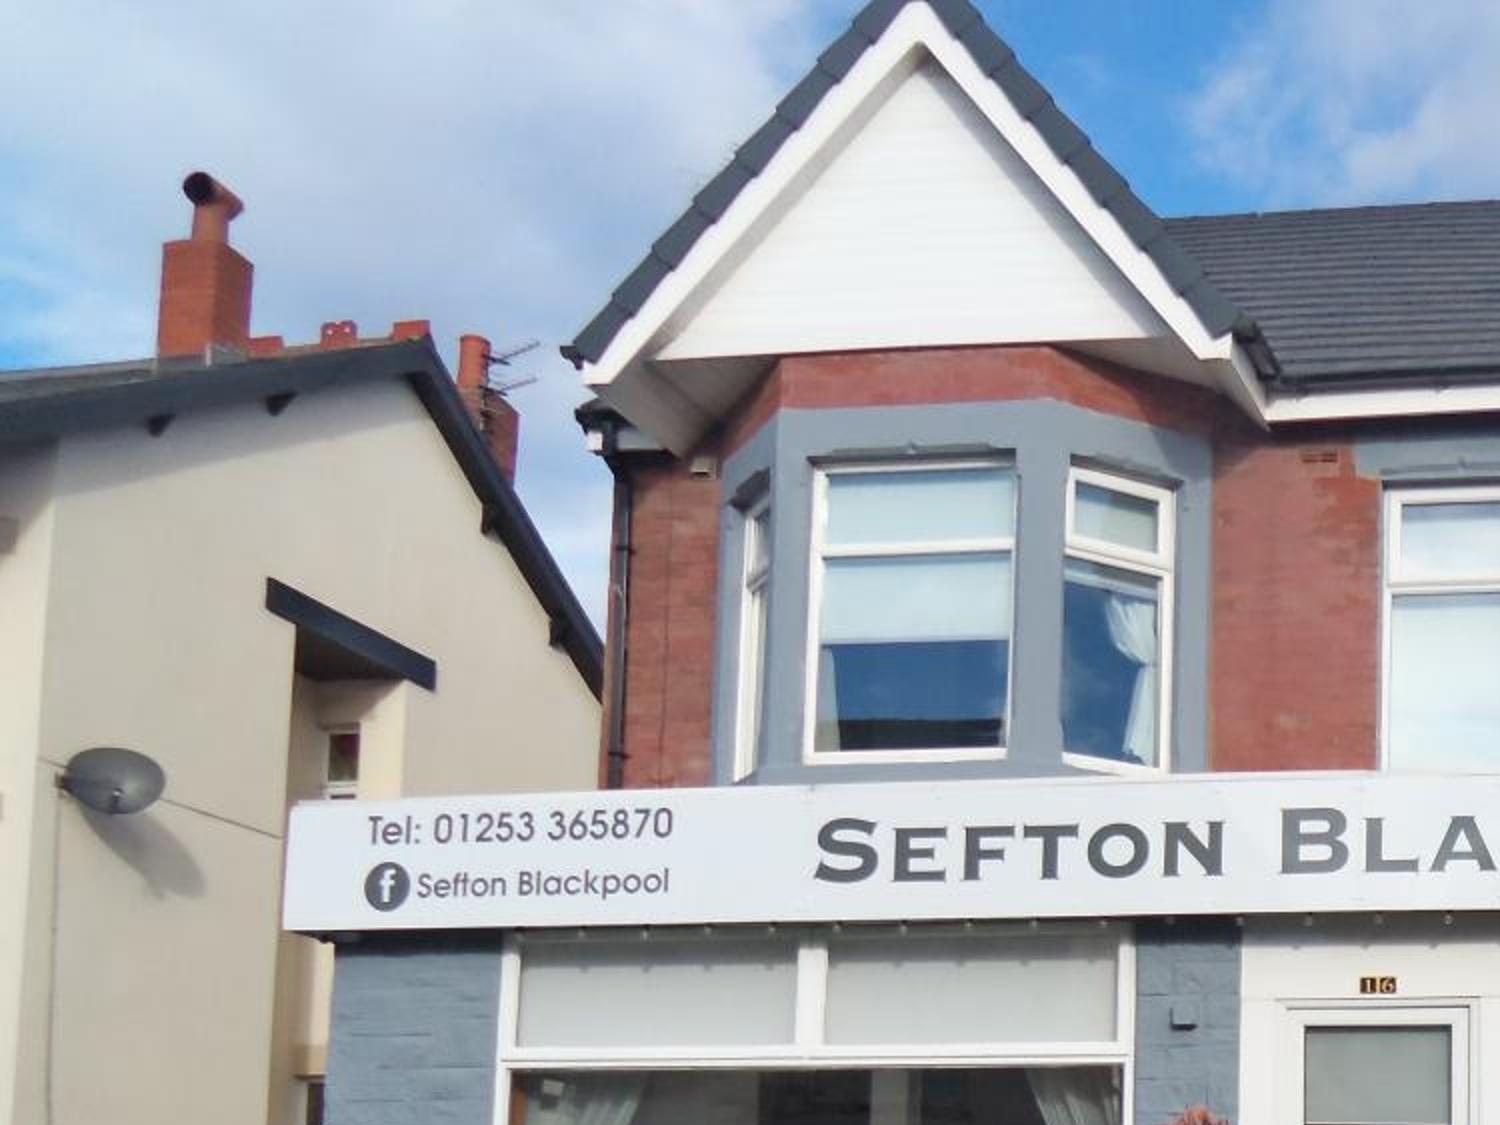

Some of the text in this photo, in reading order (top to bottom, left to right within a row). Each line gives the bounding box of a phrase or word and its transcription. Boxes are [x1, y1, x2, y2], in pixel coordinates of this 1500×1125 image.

[368, 807, 673, 845] Tel: 01253 365870
[813, 817, 1225, 884] SEFTON
[416, 872, 507, 899] Sefton
[517, 867, 670, 900] Blackpool
[1361, 977, 1397, 994] 16
